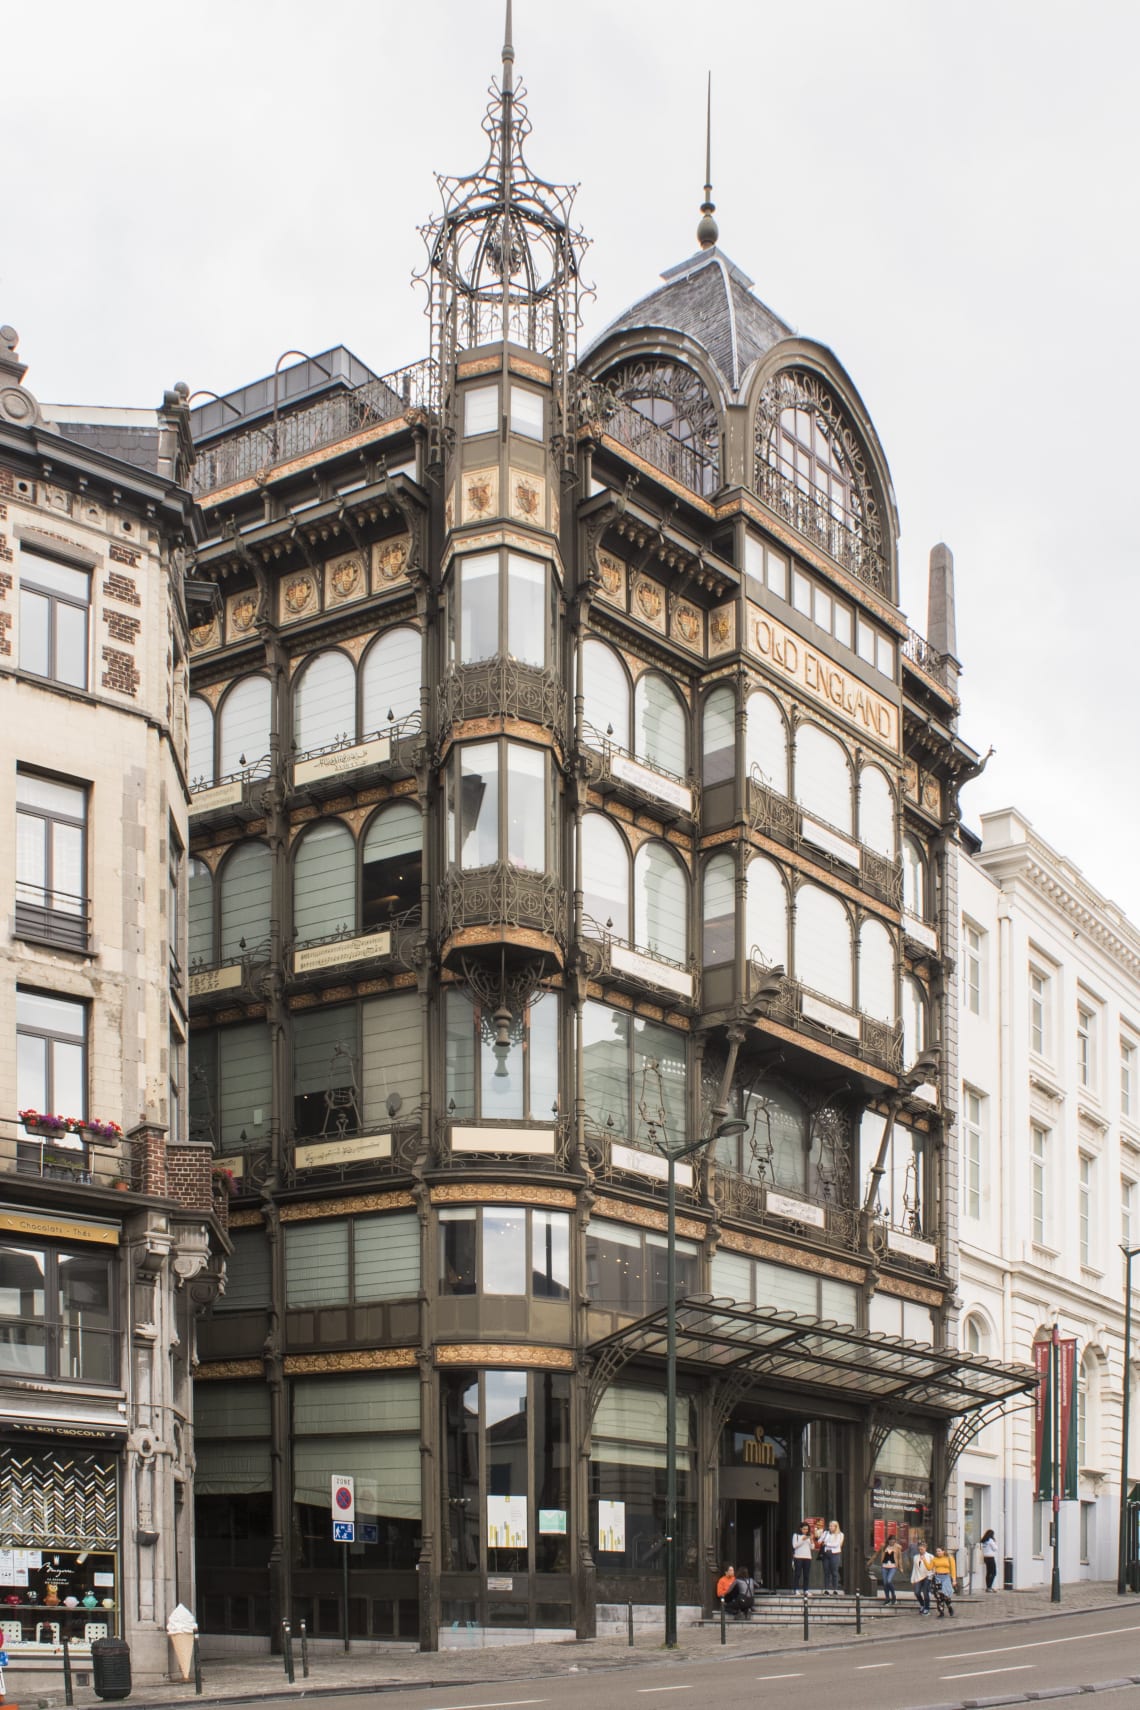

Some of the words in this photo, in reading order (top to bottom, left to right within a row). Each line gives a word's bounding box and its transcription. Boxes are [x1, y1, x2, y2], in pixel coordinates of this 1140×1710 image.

[756, 621, 798, 674] OLD
[805, 652, 891, 738] ENGLAND
[19, 1221, 63, 1234] Chocolats
[56, 1428, 106, 1437] CHOCOLAT
[743, 1431, 775, 1465] mim
